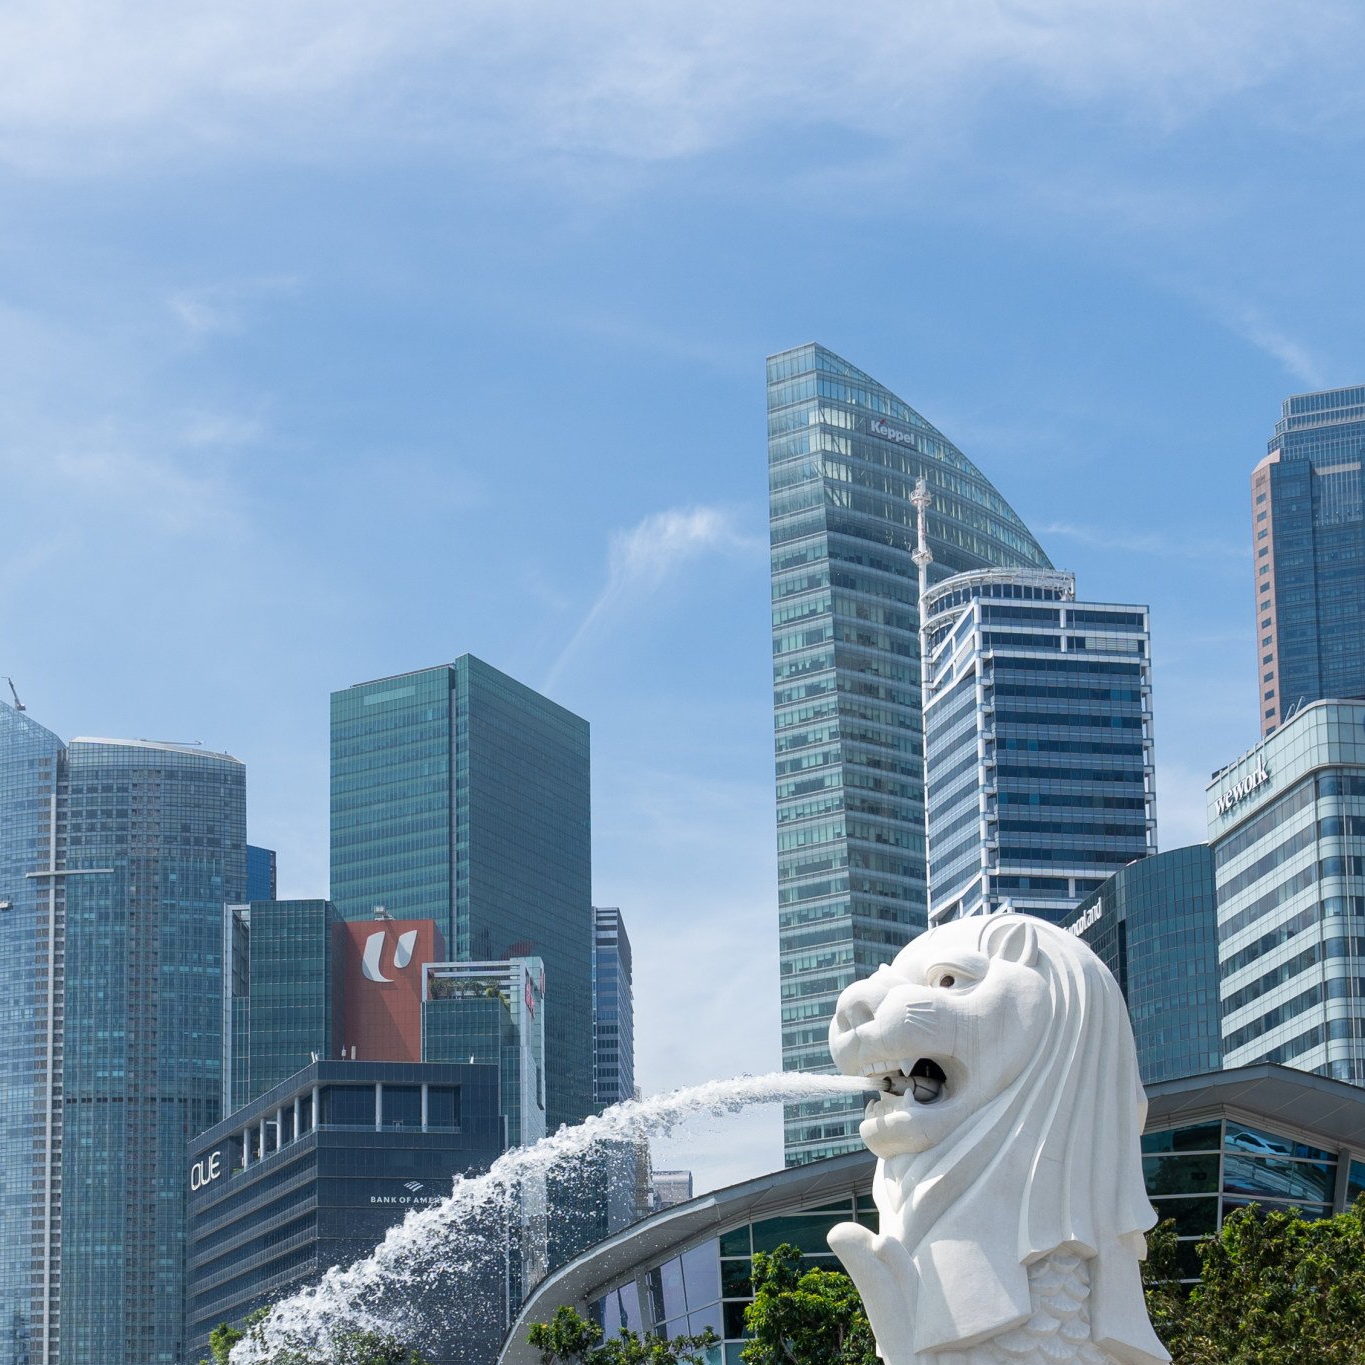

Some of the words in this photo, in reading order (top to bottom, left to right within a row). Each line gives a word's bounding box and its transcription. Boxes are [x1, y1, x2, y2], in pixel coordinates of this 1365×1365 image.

[870, 420, 915, 445] Keppel
[1215, 753, 1269, 816] wework
[190, 1151, 221, 1191] OUE
[399, 1196, 412, 1204] OF
